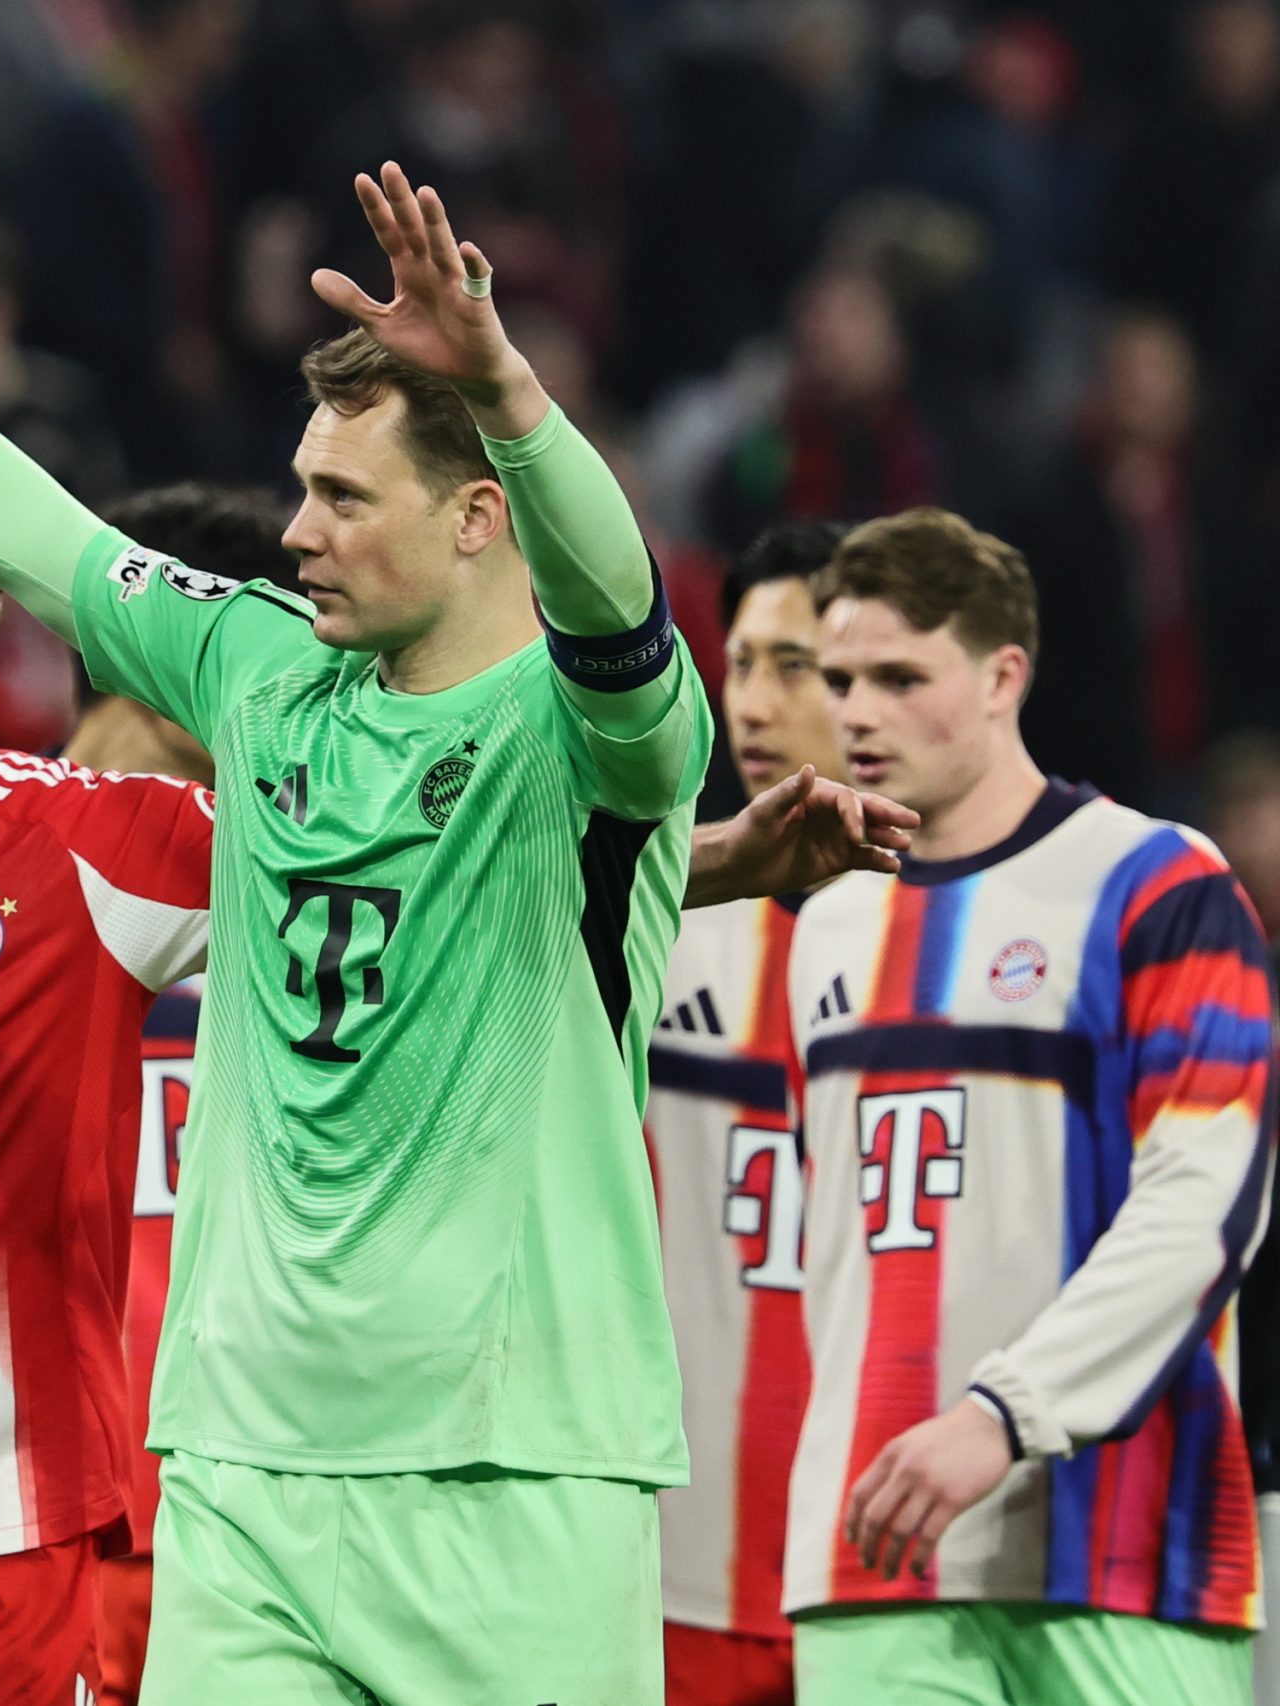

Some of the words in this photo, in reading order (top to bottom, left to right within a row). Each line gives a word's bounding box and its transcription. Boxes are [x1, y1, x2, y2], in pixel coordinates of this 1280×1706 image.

[575, 641, 659, 671] RESPECT
[423, 777, 436, 794] FC
[434, 763, 474, 778] BAYER
[278, 879, 401, 1062] T
[858, 1088, 965, 1254] T
